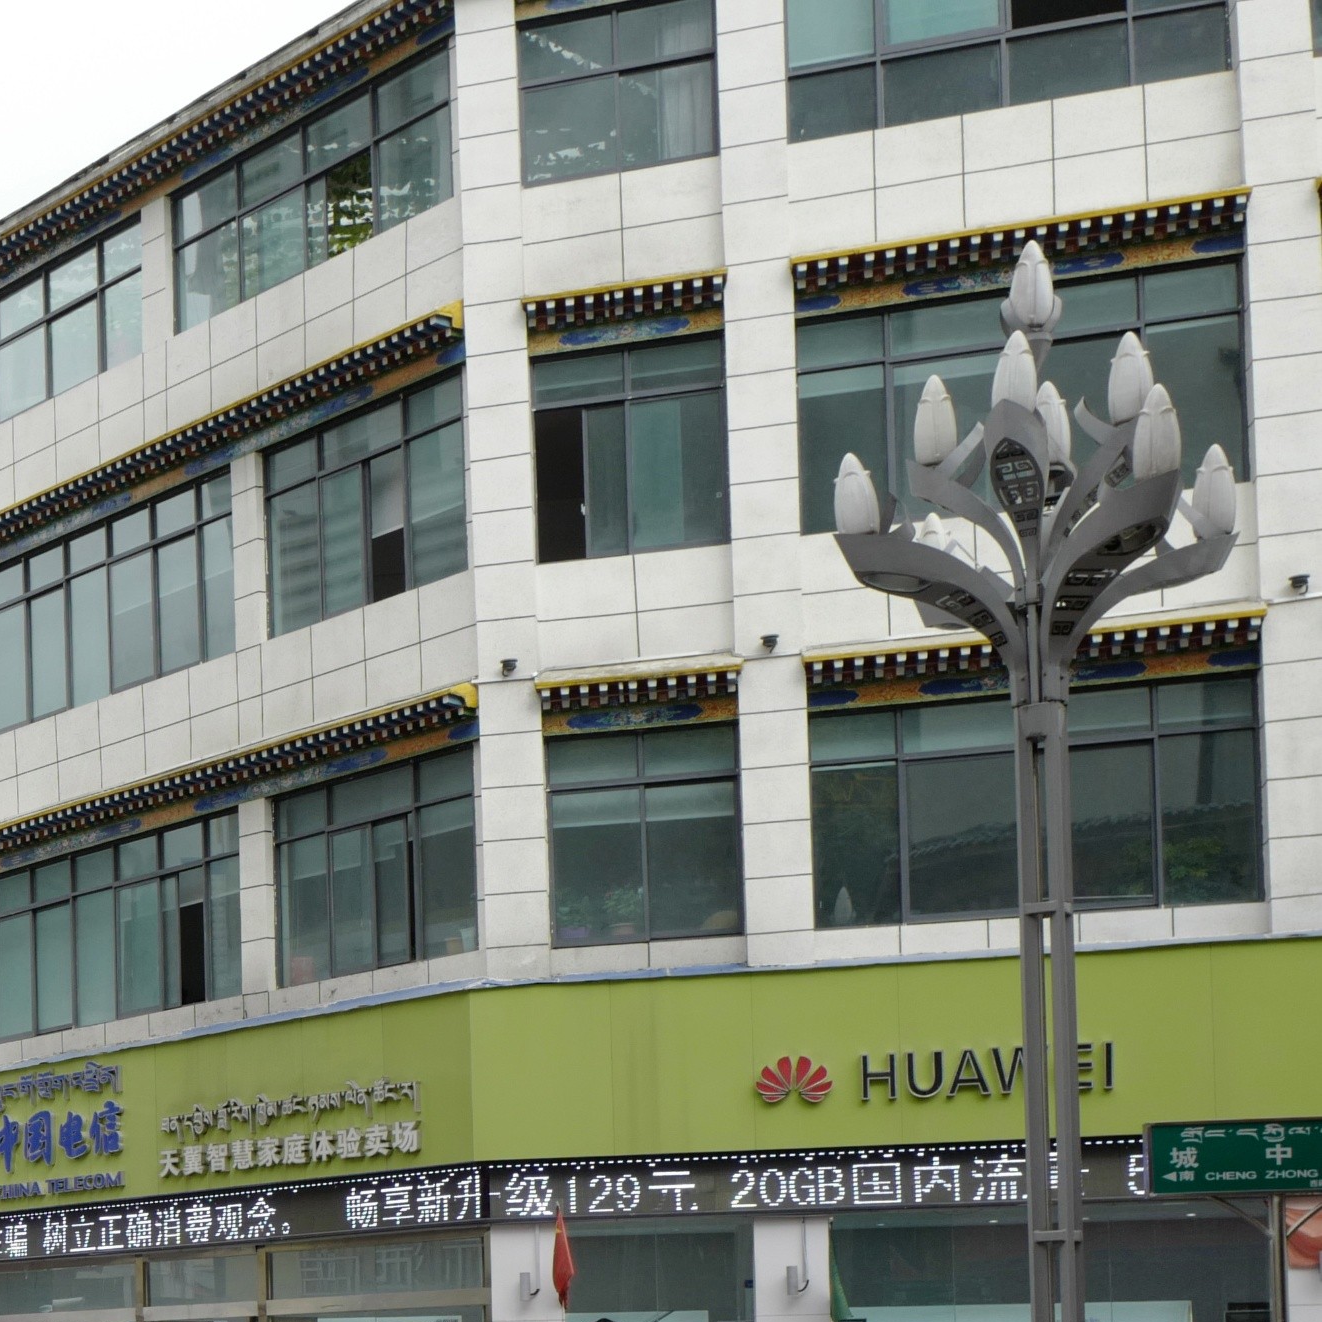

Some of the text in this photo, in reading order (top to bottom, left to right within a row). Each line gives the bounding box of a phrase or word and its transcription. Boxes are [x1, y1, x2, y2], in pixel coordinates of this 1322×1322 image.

[159, 1120, 422, 1178] 天翼智慧家庭体验卖场
[46, 1171, 125, 1193] TELECOM
[1179, 1169, 1319, 1181] 南 CHENG ZHONG
